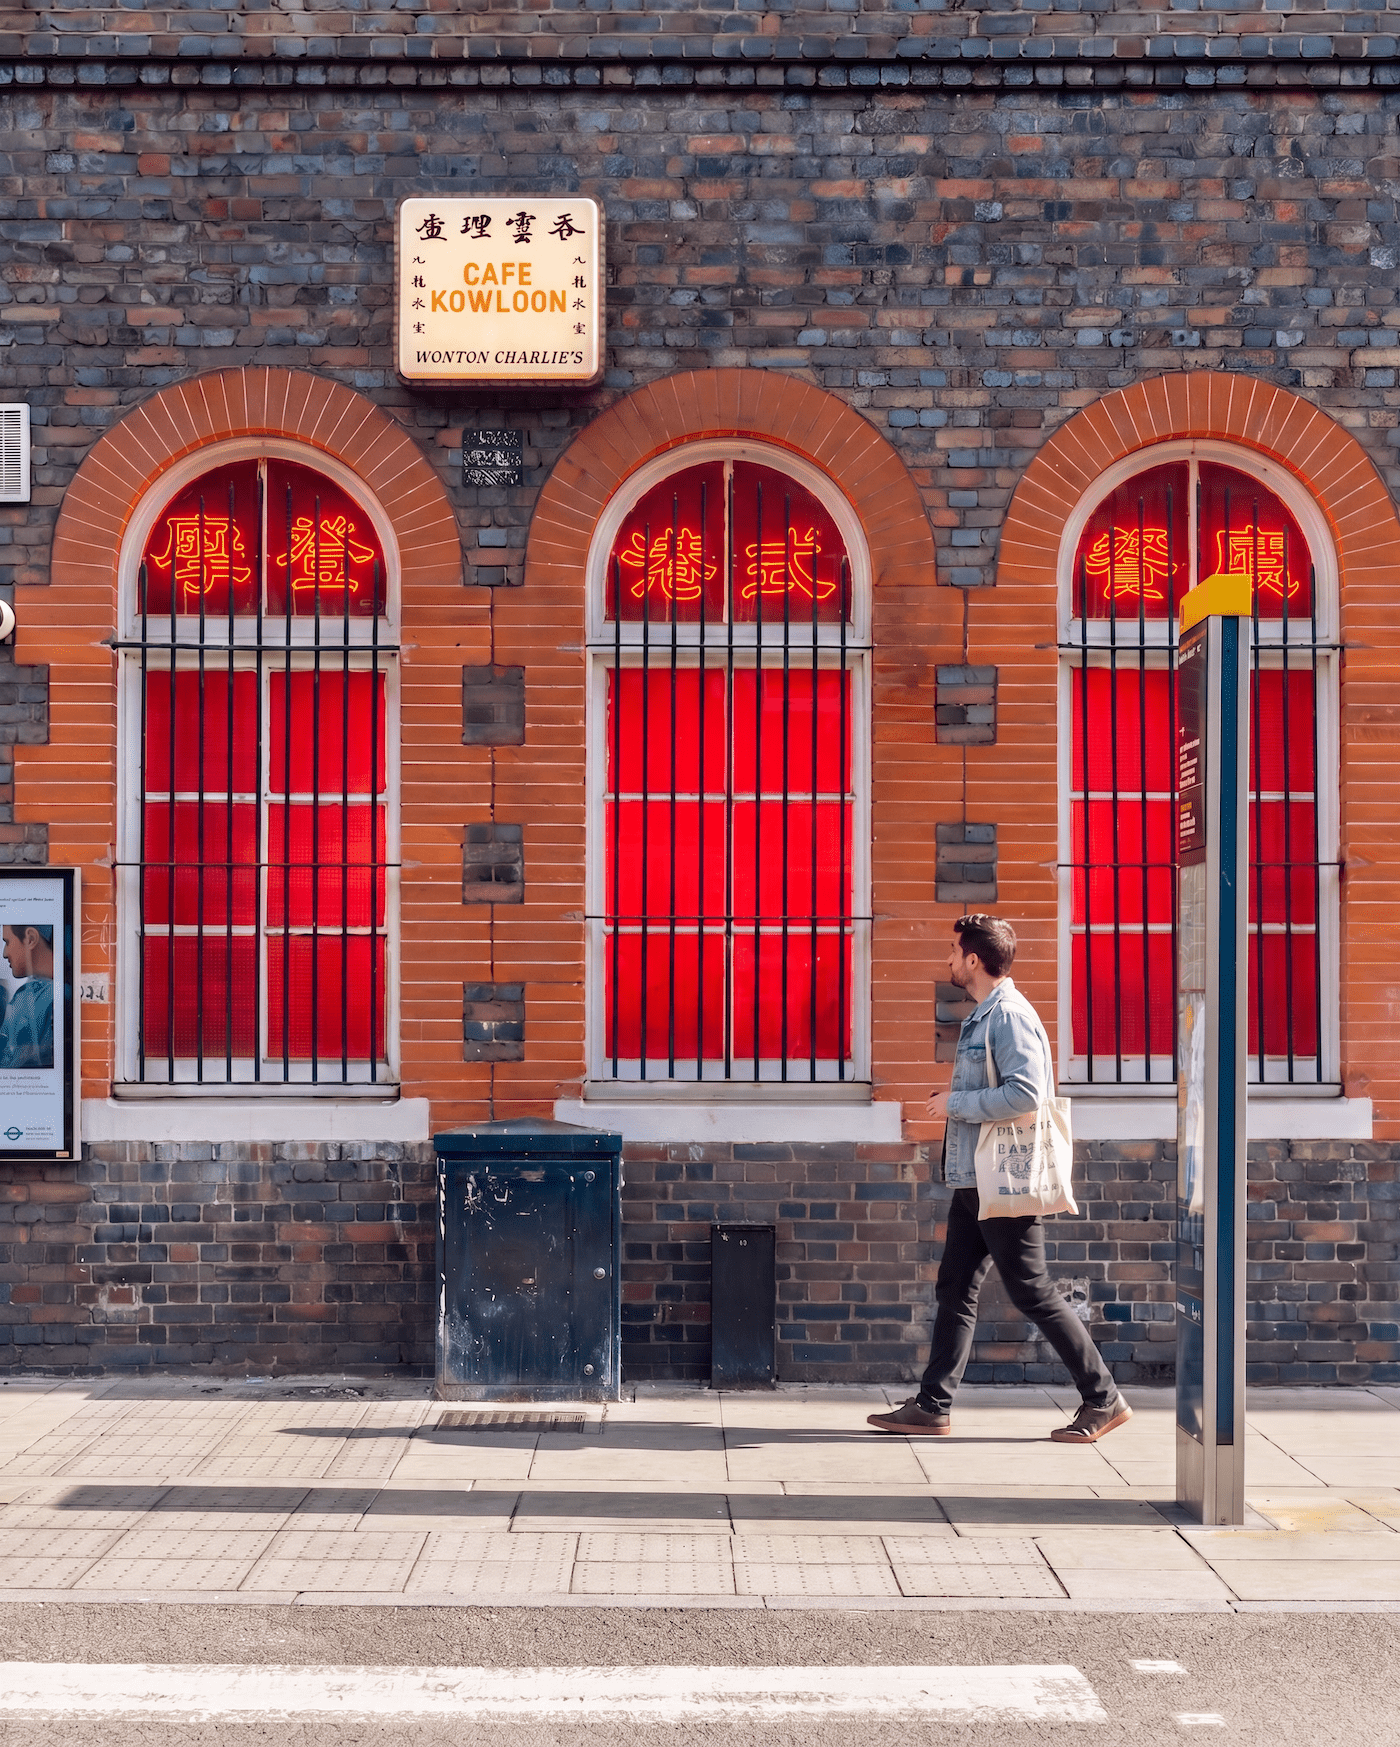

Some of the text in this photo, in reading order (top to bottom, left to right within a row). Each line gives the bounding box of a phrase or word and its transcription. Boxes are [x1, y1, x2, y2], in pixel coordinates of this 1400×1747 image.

[416, 211, 586, 244] 查理雲吞
[463, 262, 532, 286] CAFE
[431, 289, 567, 313] KOWLOON
[416, 350, 584, 365] WONTON CHARLIE'S
[621, 527, 836, 600] 港式
